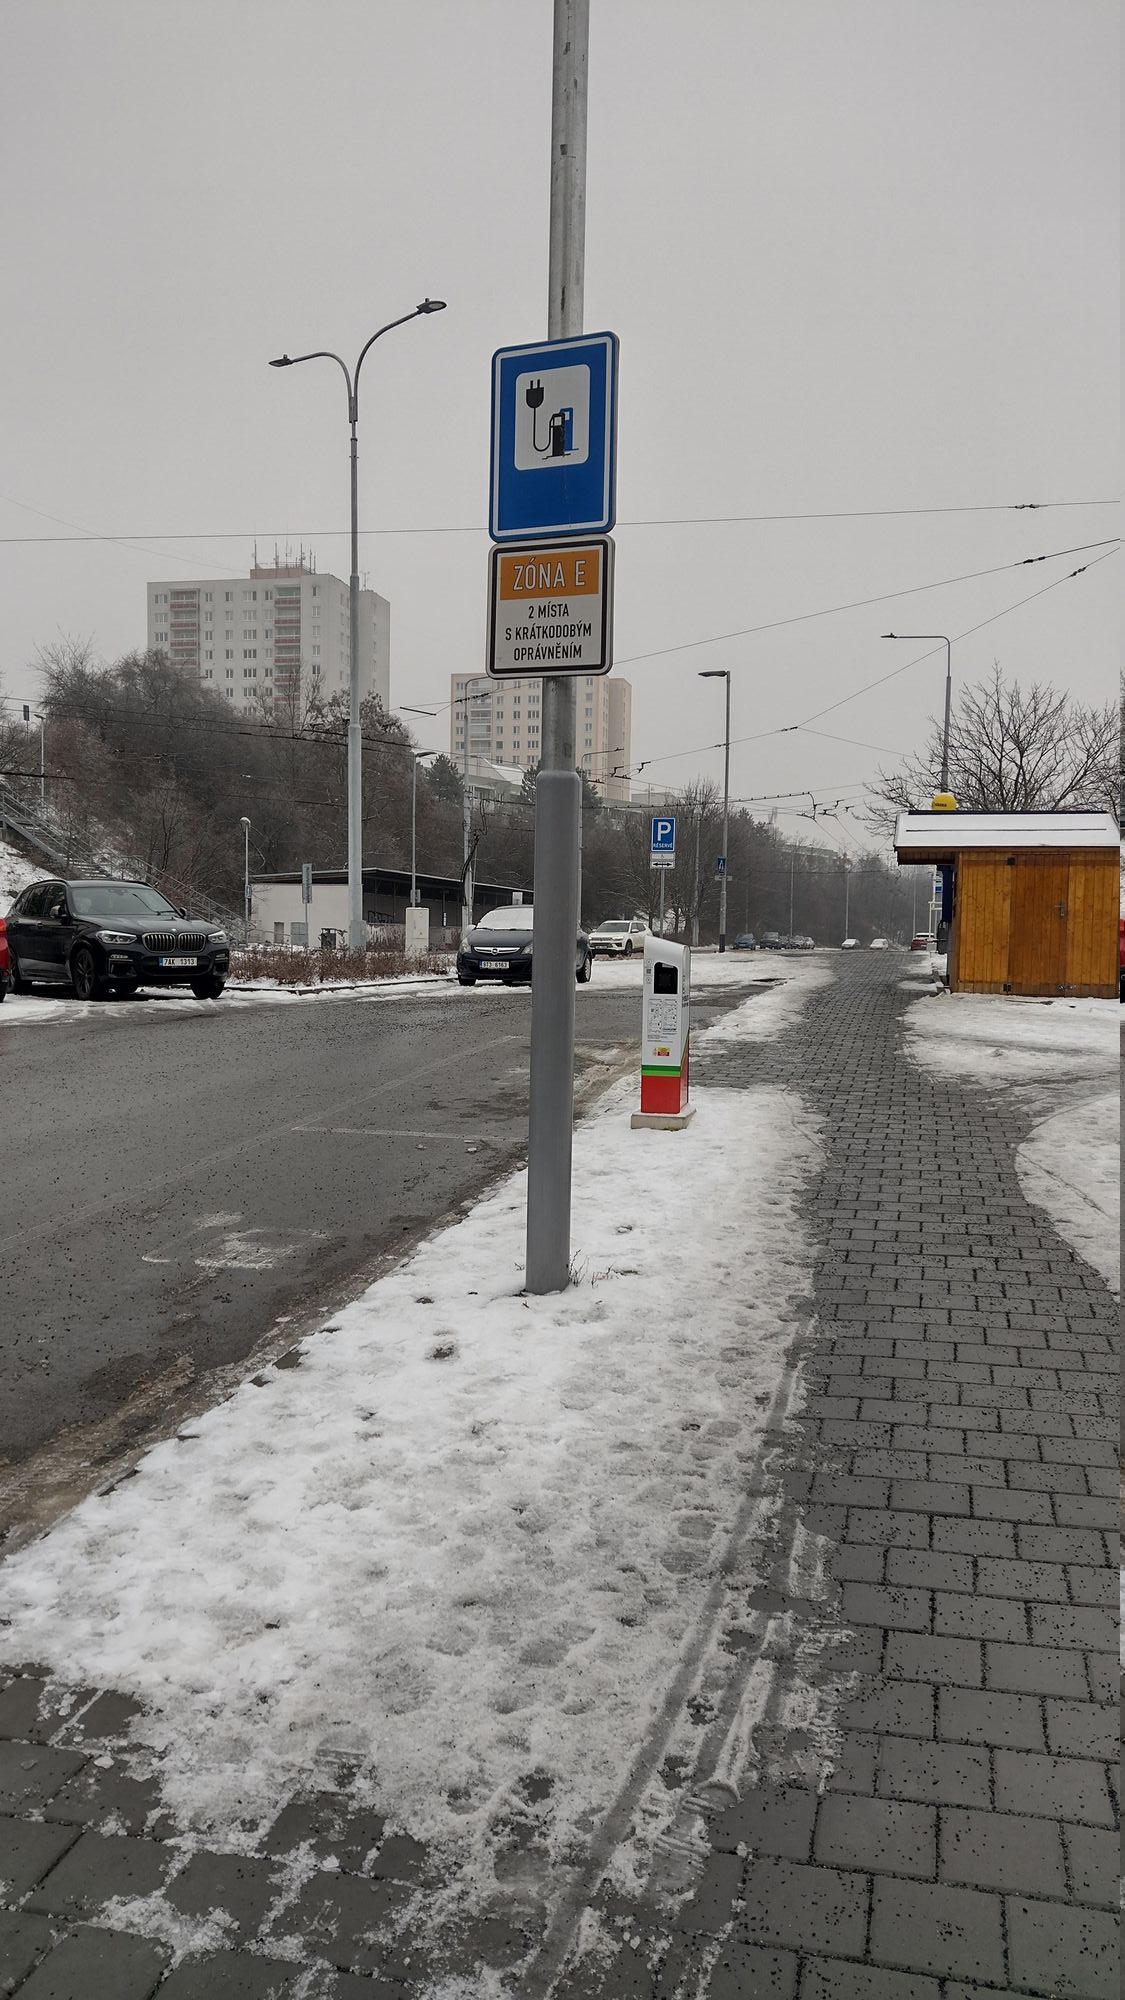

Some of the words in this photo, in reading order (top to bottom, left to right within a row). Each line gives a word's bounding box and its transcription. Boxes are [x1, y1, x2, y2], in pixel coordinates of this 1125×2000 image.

[513, 557, 566, 591] ZÓNA
[575, 560, 586, 588] E
[528, 605, 534, 619] 2
[538, 601, 569, 618] MÍSTA
[505, 627, 512, 641] S
[515, 620, 592, 641] KRÁTKODOBÝM
[513, 642, 582, 661] OPRÁVNĚNÍM
[657, 821, 671, 841] P
